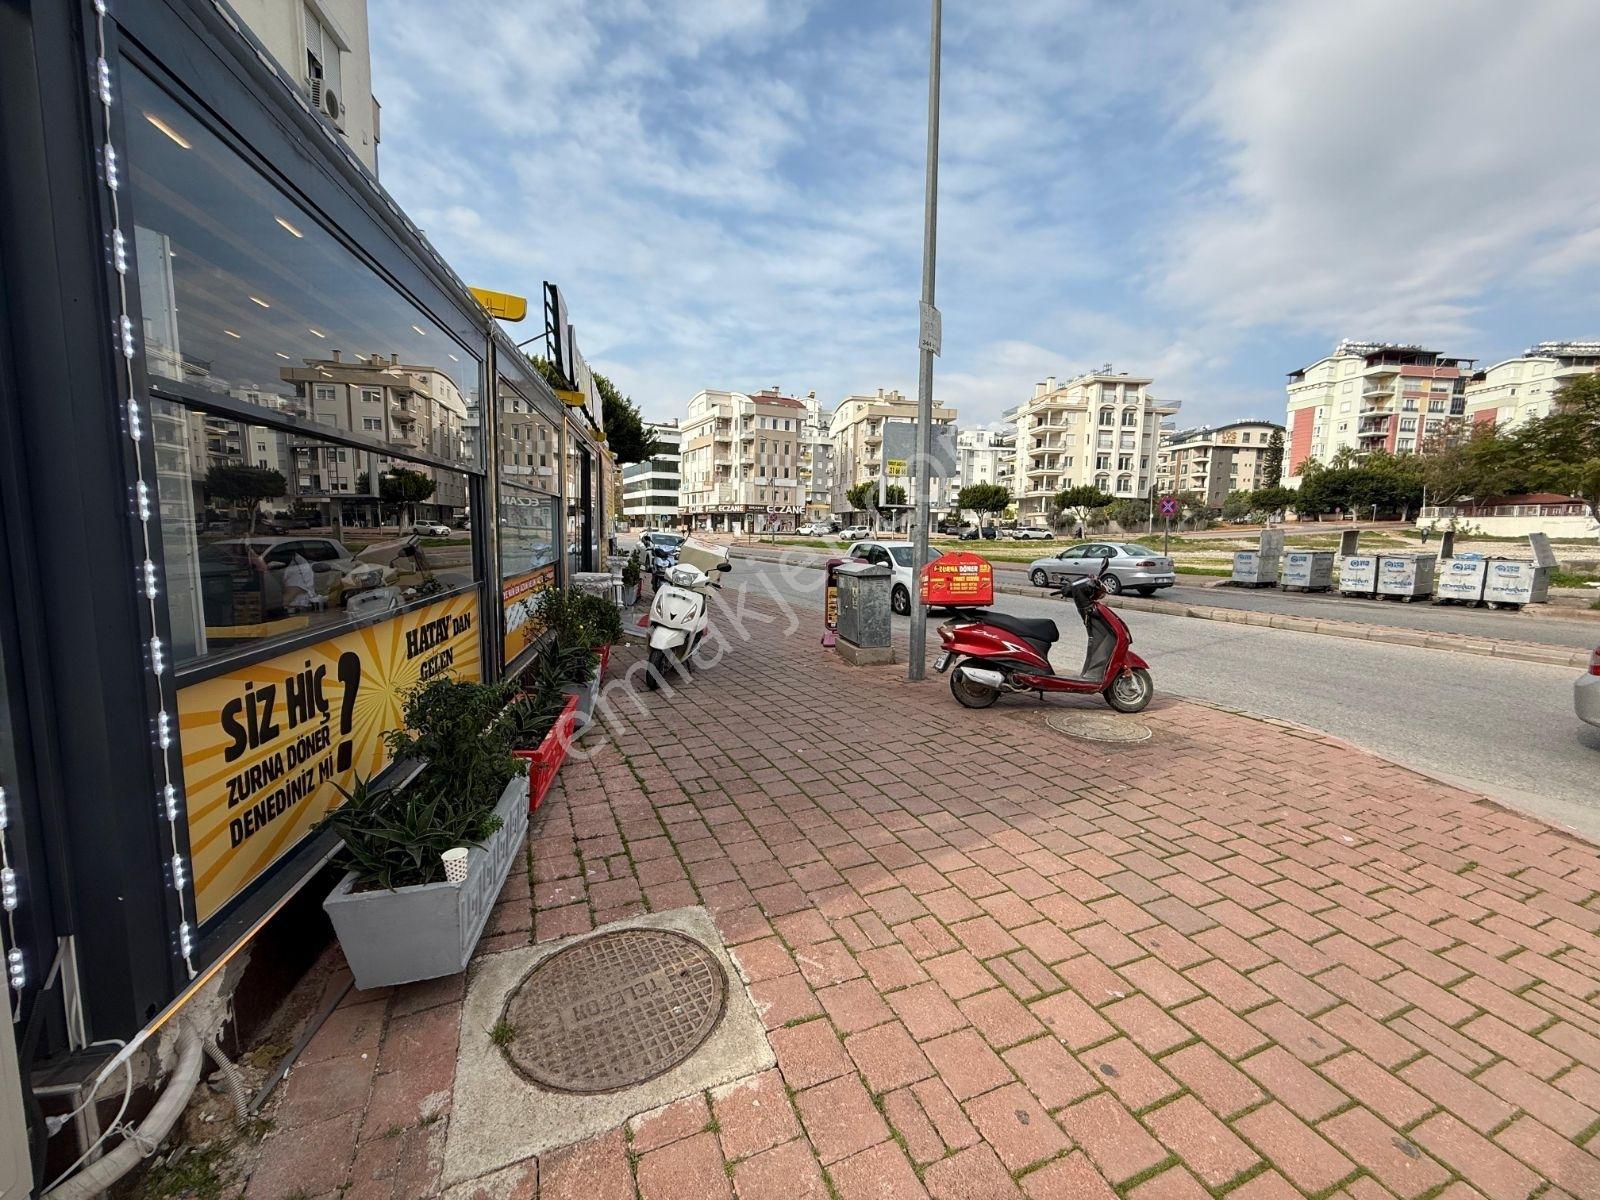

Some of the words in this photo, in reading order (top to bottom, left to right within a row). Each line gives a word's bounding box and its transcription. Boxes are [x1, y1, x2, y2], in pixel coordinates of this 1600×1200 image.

[766, 505, 806, 515] ECZANE
[420, 648, 454, 681] GELEN
[220, 681, 280, 763] SİZ
[285, 660, 330, 728] HİÇ
[225, 752, 284, 809] ZURNA
[286, 725, 331, 772] DÖNER
[229, 772, 316, 849] DENEDİNİZ
[318, 751, 334, 784] Mİ
[573, 978, 662, 1022] TELEFON
